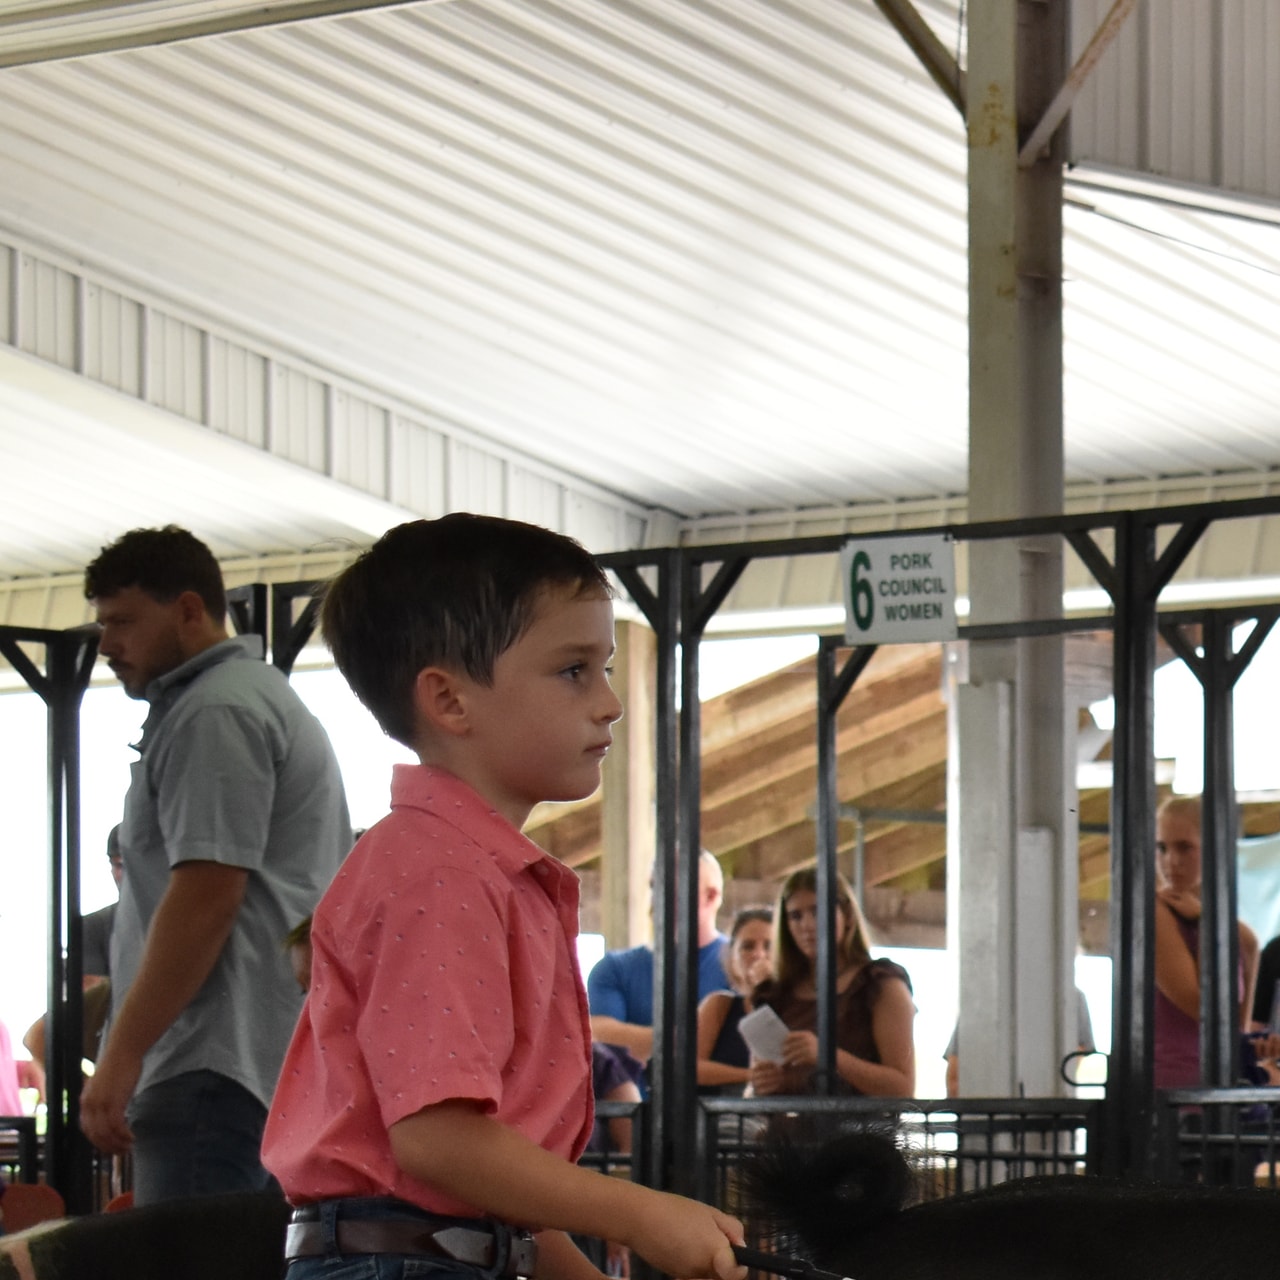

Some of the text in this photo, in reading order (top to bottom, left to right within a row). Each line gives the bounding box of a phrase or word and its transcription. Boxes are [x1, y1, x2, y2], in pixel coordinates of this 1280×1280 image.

[890, 552, 933, 571] PORK
[850, 550, 874, 632] 6
[879, 577, 947, 597] COUNCIL
[884, 603, 943, 621] WOMEN
